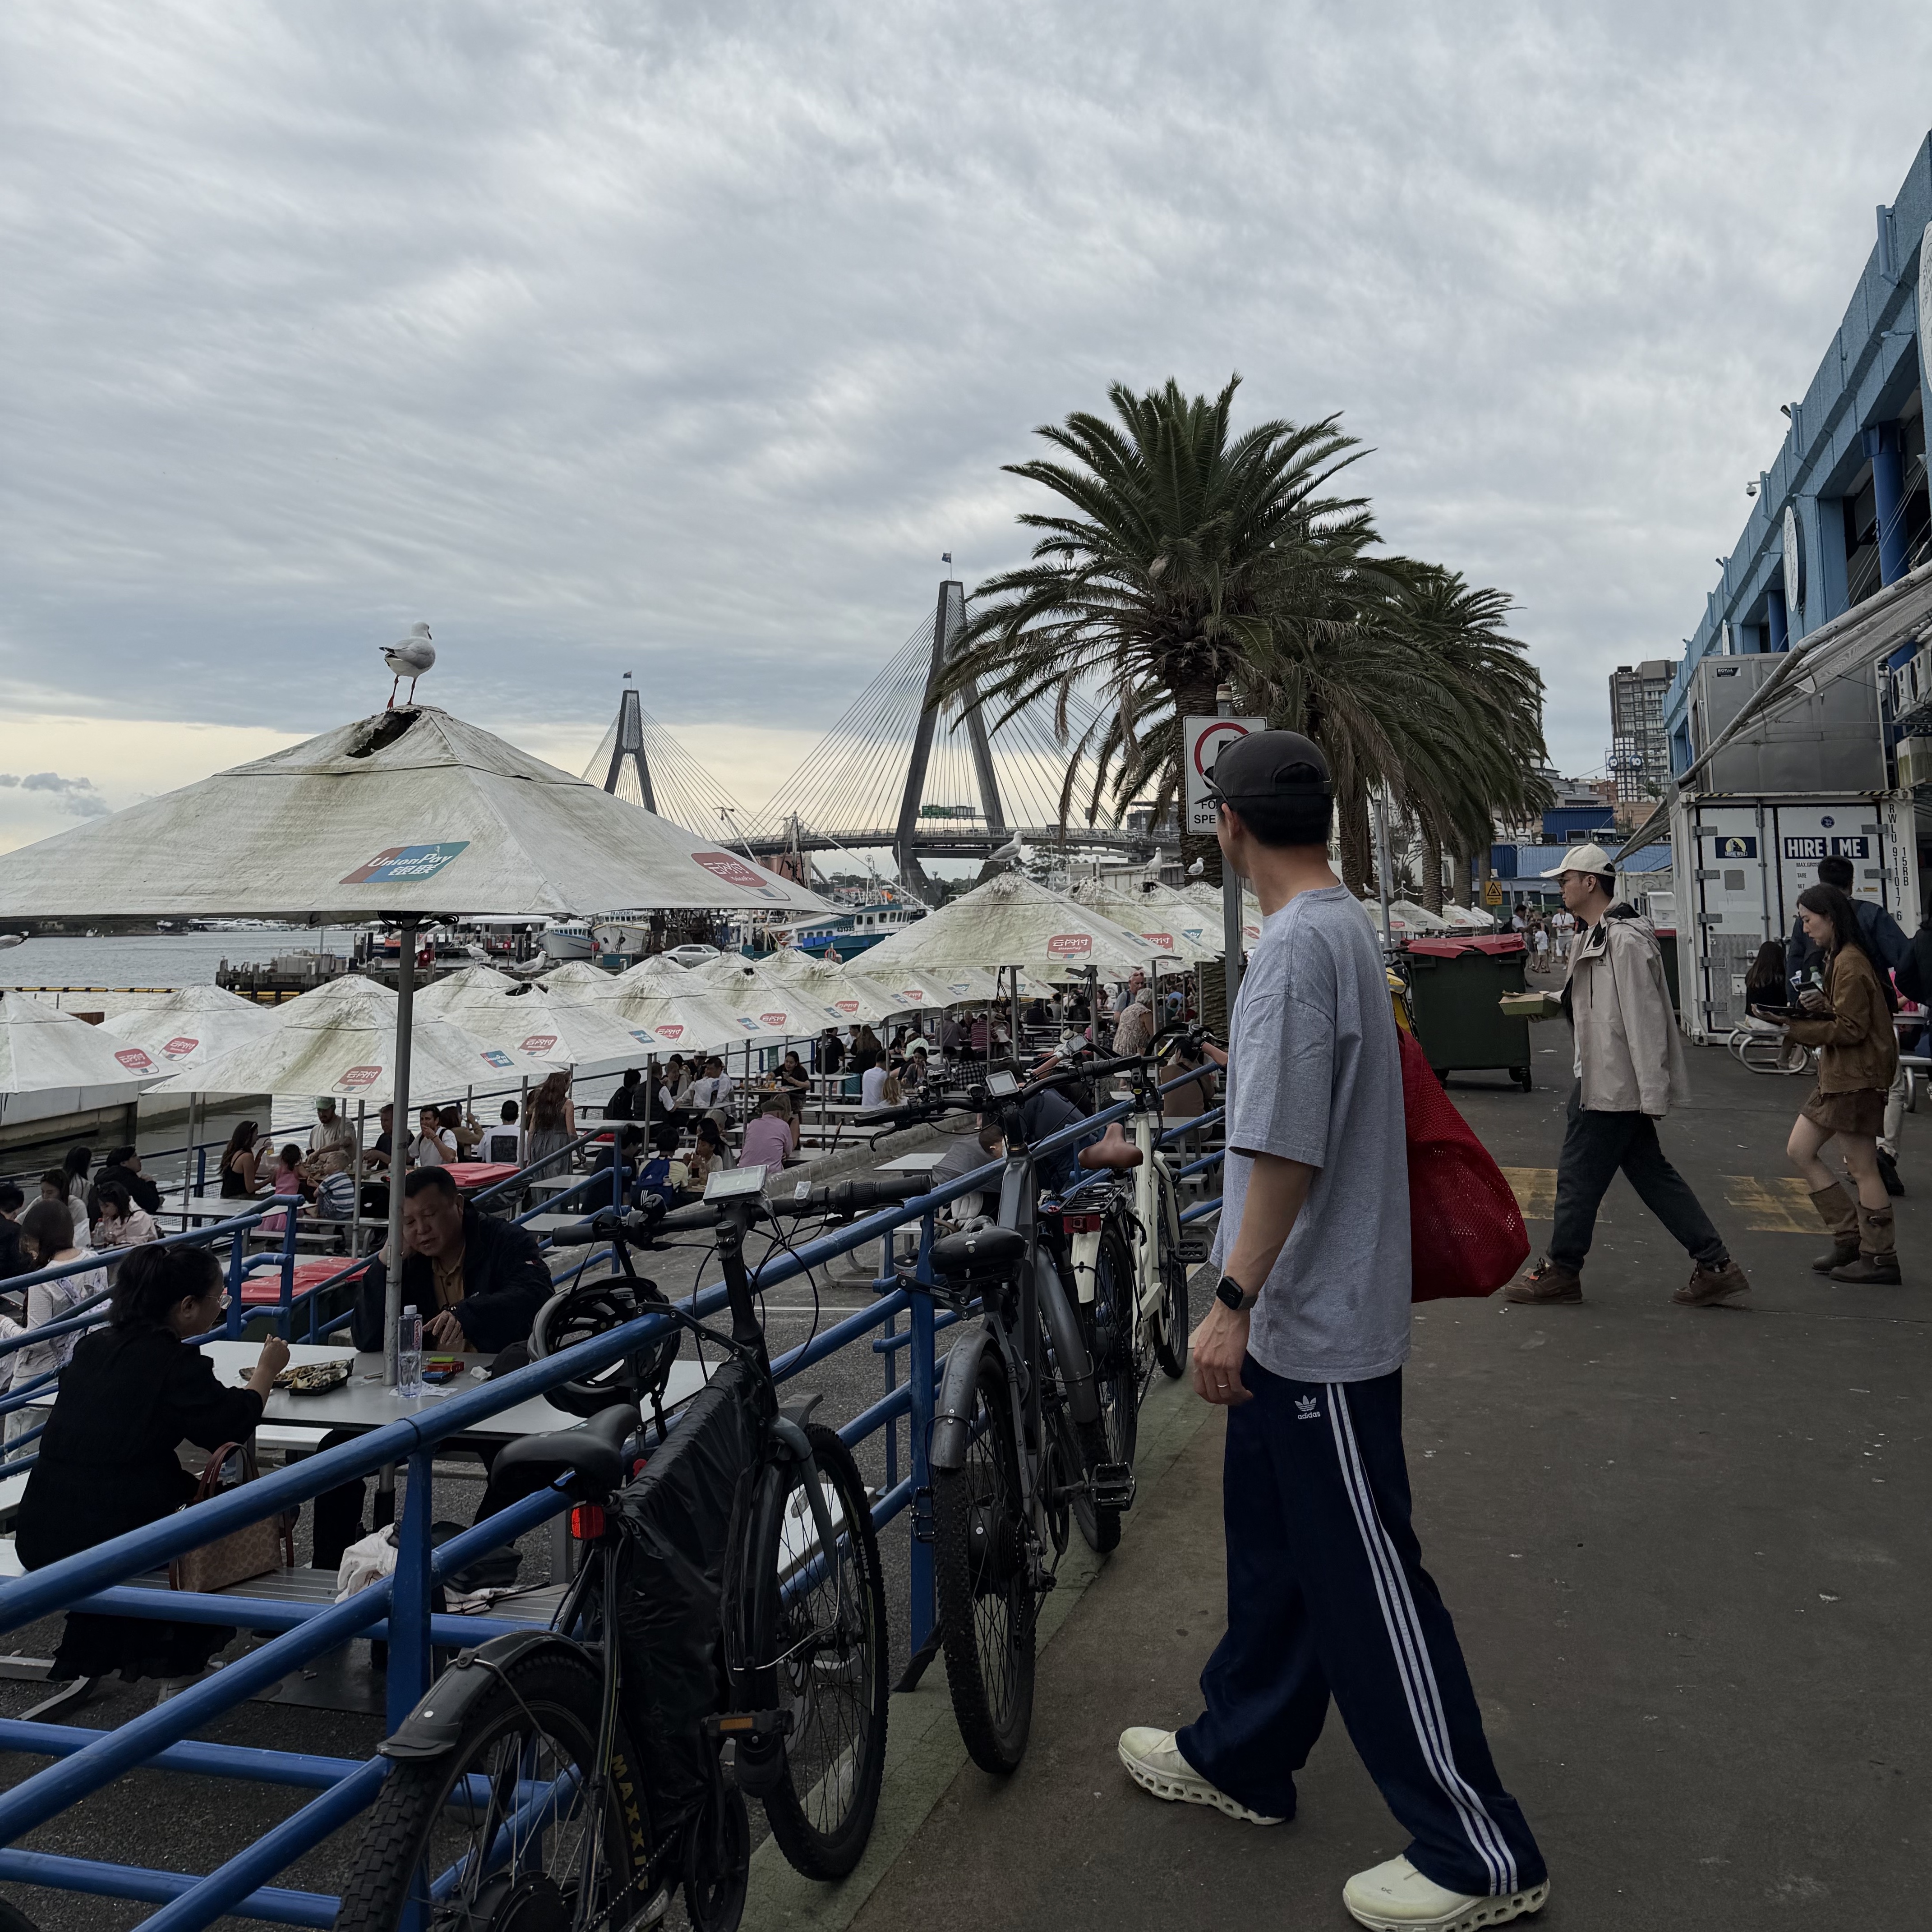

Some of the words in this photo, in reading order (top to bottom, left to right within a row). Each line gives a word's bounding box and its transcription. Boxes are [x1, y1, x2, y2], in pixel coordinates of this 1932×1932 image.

[1194, 814, 1216, 823] SPE
[1787, 839, 1824, 857] HIRE
[1839, 839, 1862, 857] ME
[368, 853, 453, 867] UnionPay
[1298, 1412, 1321, 1420] adidas
